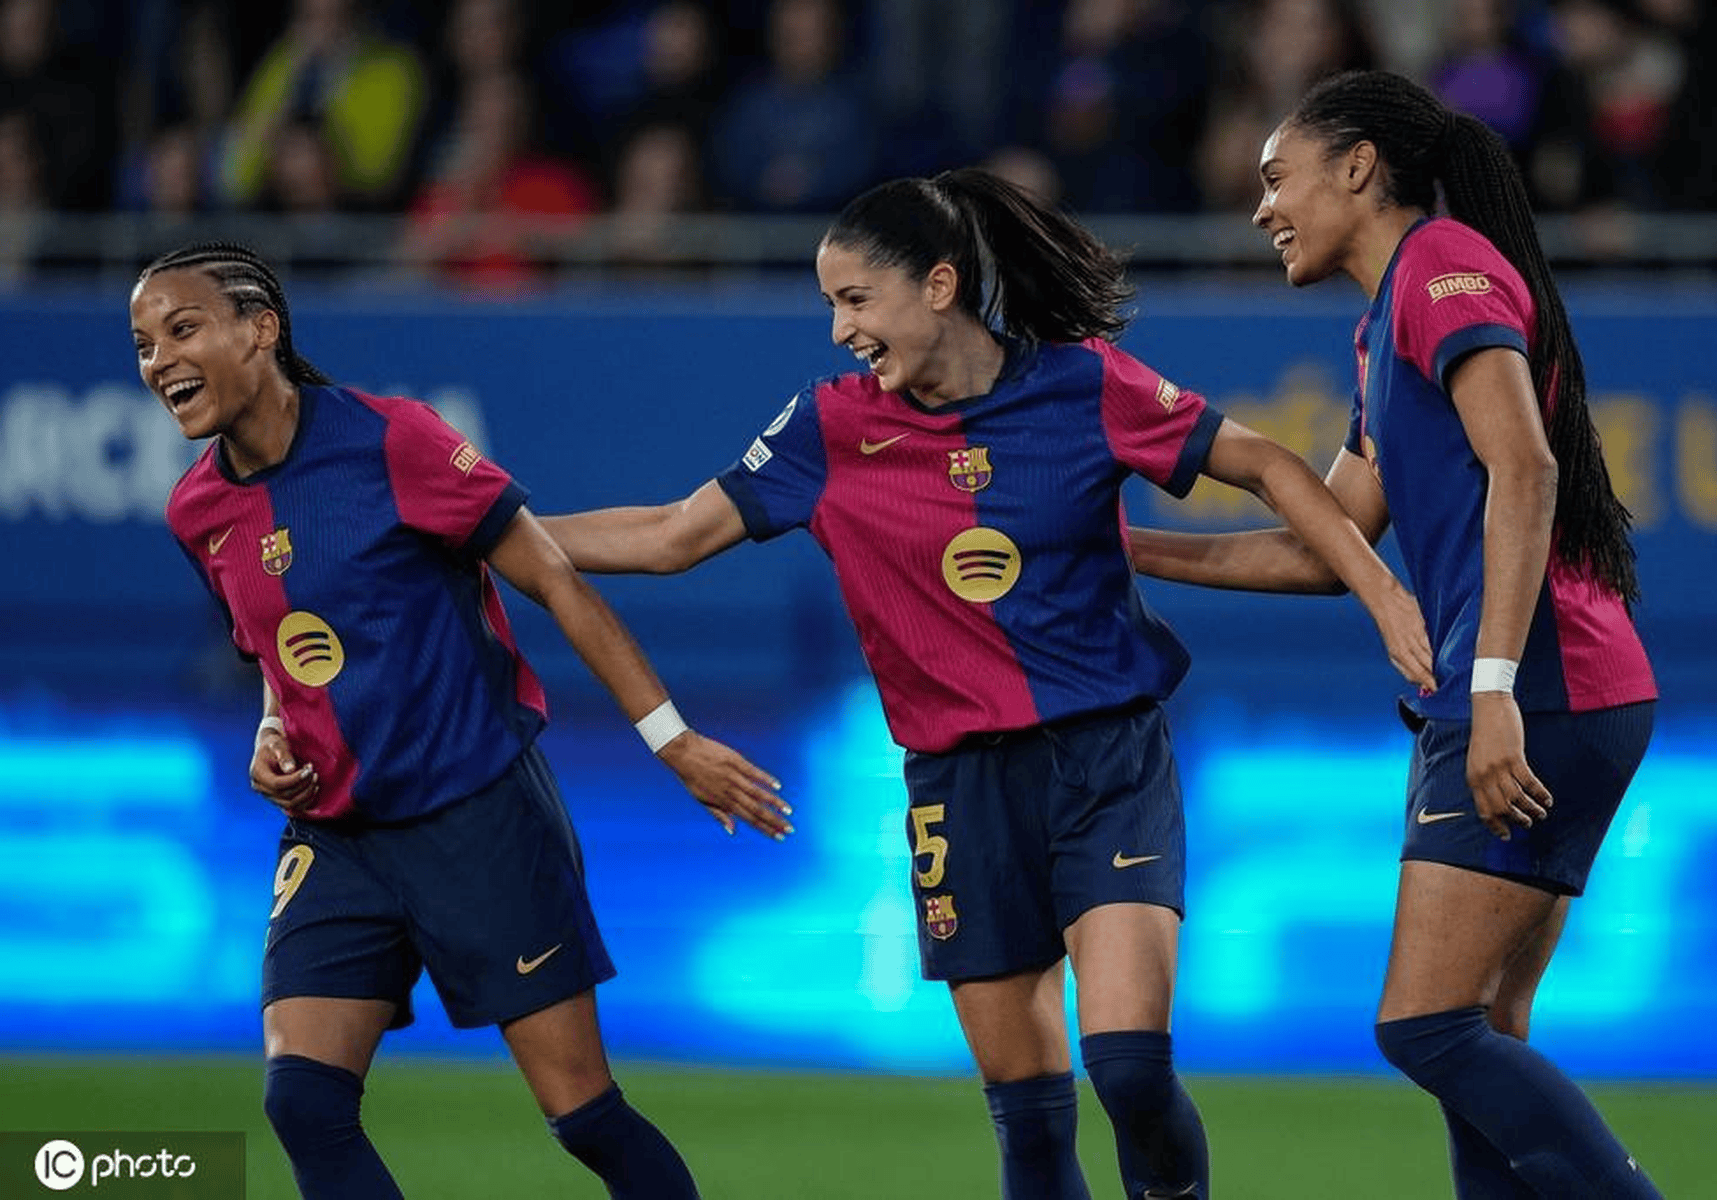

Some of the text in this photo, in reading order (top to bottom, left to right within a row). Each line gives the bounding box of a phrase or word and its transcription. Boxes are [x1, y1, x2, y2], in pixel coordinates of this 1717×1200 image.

[1428, 276, 1490, 299] BIMBO
[270, 844, 315, 919] 9
[911, 804, 948, 888] 5
